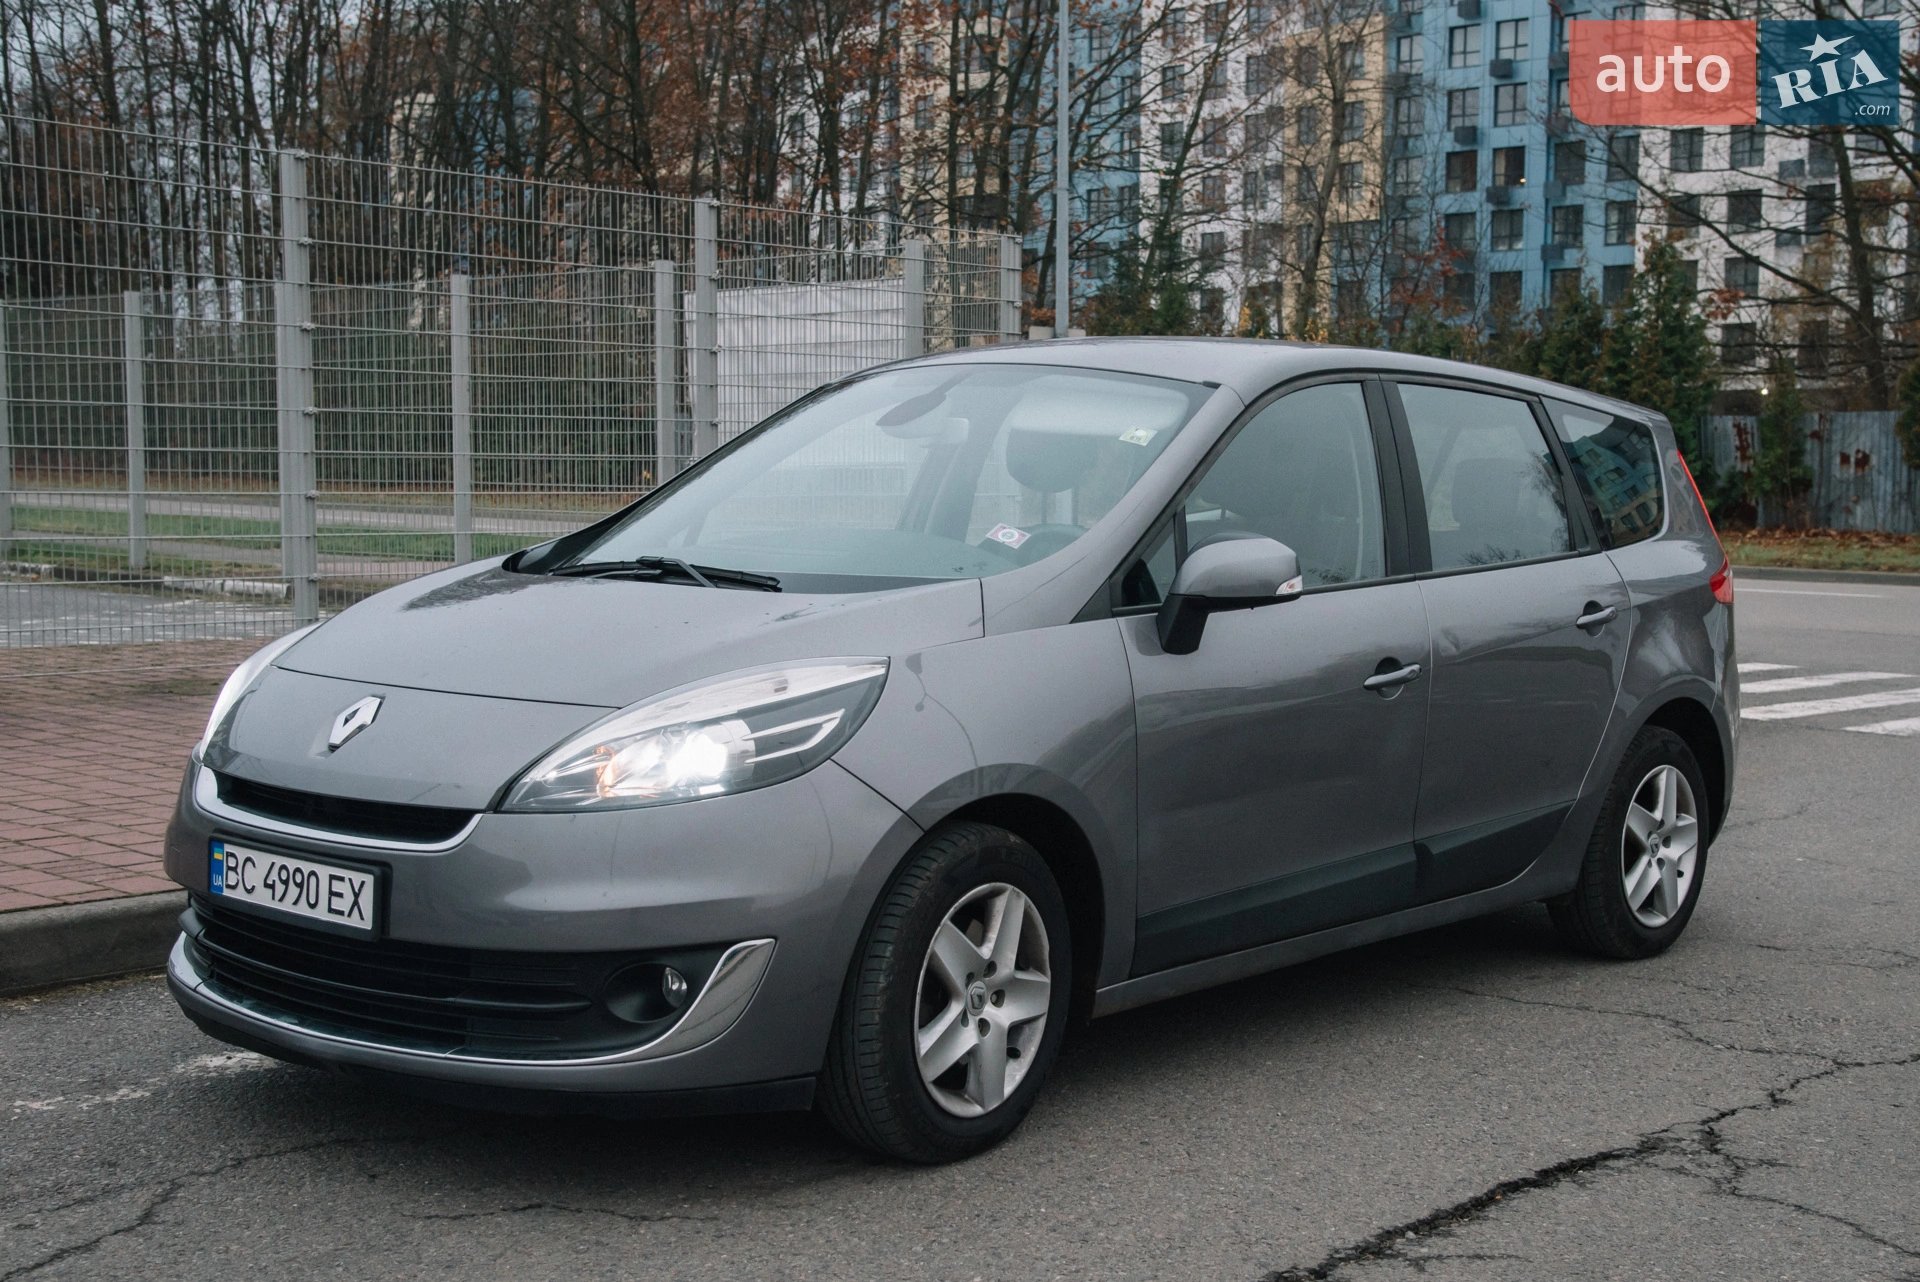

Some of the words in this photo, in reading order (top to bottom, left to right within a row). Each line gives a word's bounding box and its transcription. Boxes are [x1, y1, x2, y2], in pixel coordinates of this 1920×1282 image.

[213, 874, 223, 887] UA
[225, 850, 256, 894] BC
[263, 861, 320, 910] 4990
[327, 873, 366, 921] EX
